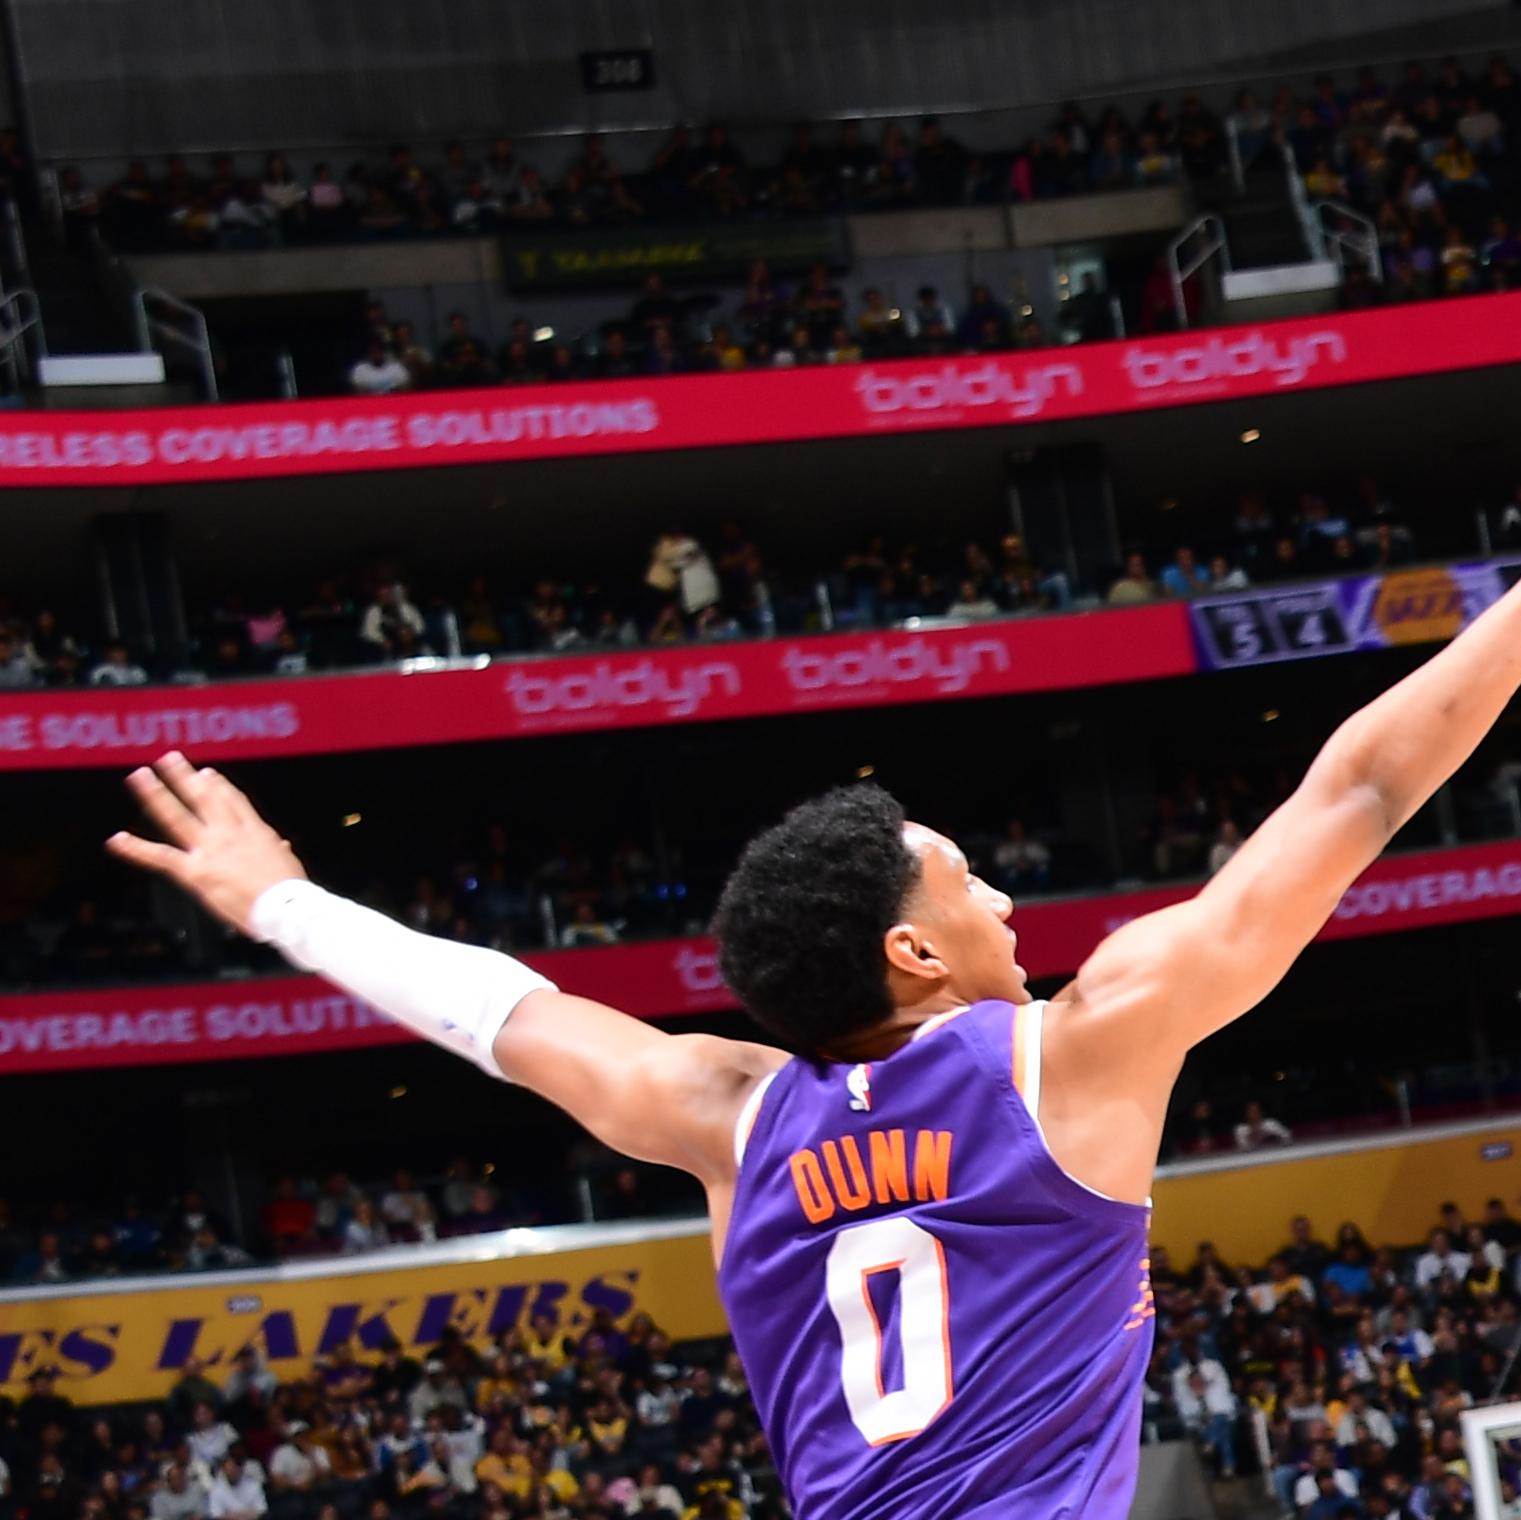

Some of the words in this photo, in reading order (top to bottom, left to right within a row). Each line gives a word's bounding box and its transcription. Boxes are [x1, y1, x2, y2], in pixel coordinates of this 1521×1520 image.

[856, 360, 1083, 417] boldyn
[1123, 330, 1346, 392] boldyn
[160, 415, 401, 464] COVERAGE
[407, 400, 659, 449] SOLUTIONS
[507, 660, 742, 719] boldyn
[783, 635, 1010, 695] boldyn
[43, 703, 299, 752] SOLUTIONS
[205, 992, 398, 1043] SOLUTI
[788, 1127, 954, 1225] DUNN
[157, 1269, 642, 1370] LAKERS
[825, 1215, 955, 1448] 0
